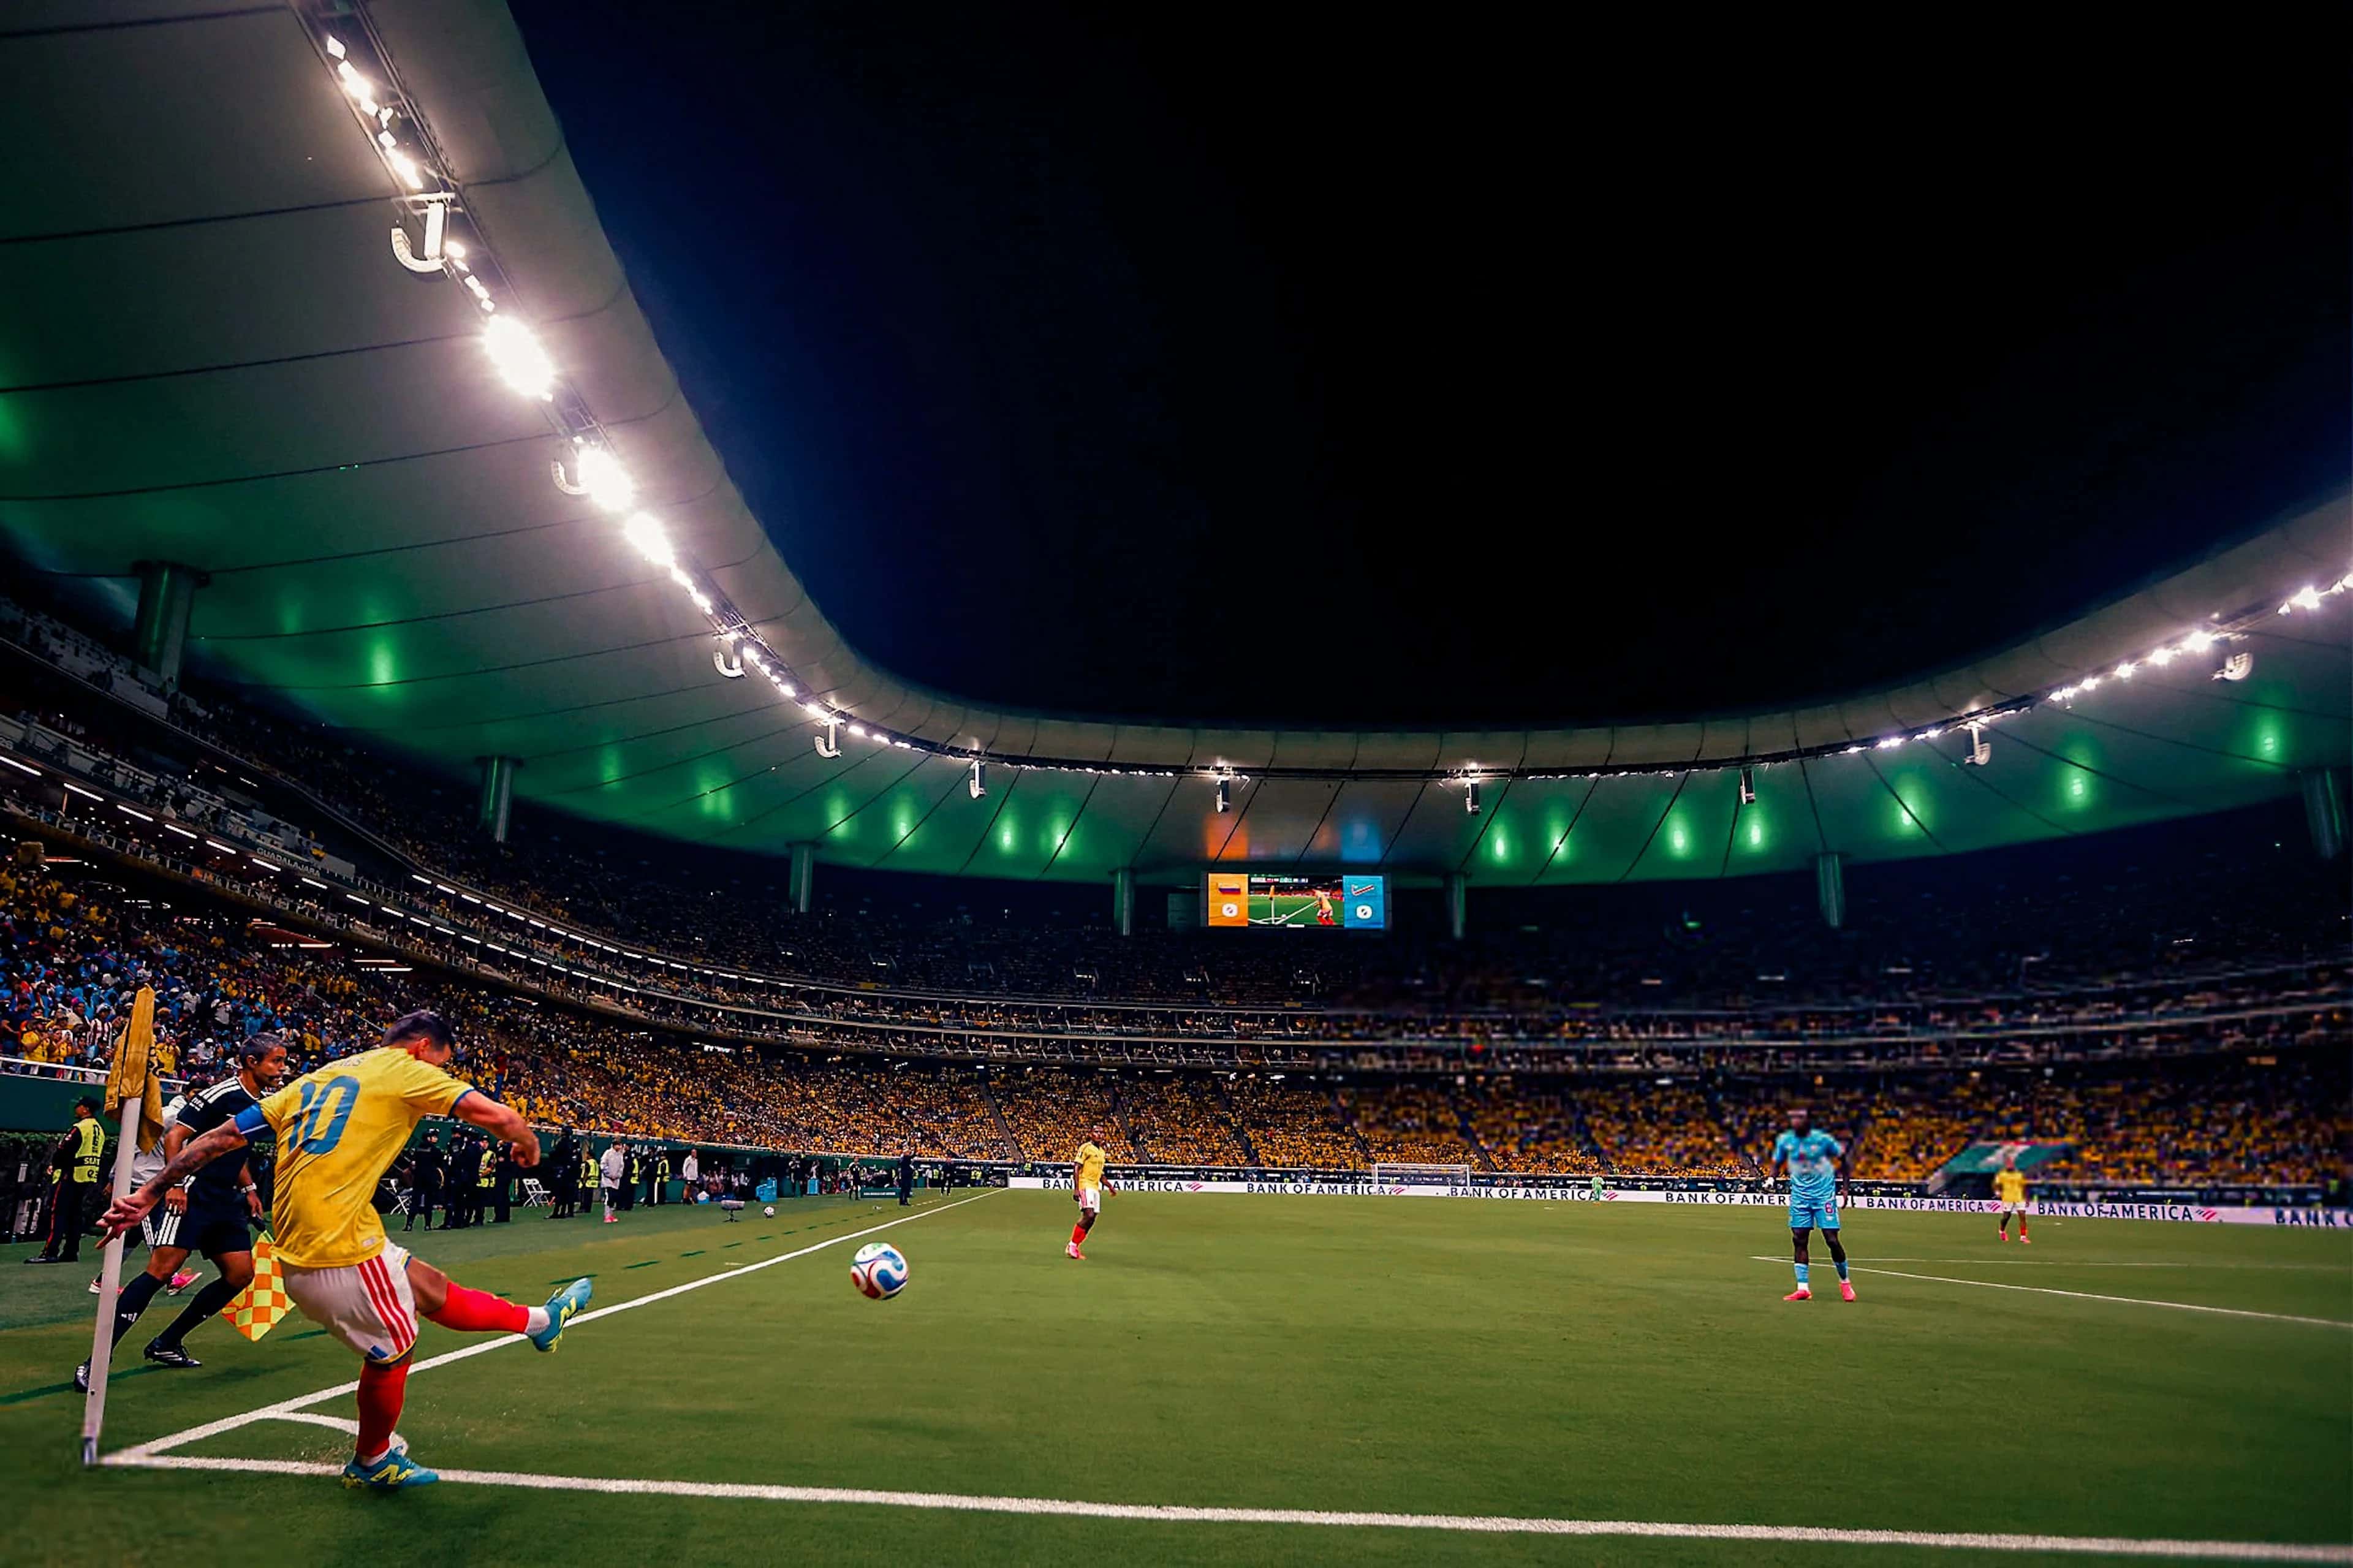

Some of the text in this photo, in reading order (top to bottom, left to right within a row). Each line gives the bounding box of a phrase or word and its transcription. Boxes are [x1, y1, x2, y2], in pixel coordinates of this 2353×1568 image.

[257, 847, 320, 876] GUADALAJARA
[288, 1075, 361, 1155] 10
[1043, 1179, 1072, 1189] BAN
[1113, 1181, 1183, 1192] AMERICA
[1247, 1183, 1386, 1195] BANK OF AMERICA
[1450, 1187, 1595, 1201] BANK OF AMERICA
[1666, 1192, 1787, 1206] BANK OF AMER
[1866, 1198, 1985, 1213] BANK OF AMERICA
[2038, 1203, 2193, 1221] BANK OF AMERICA
